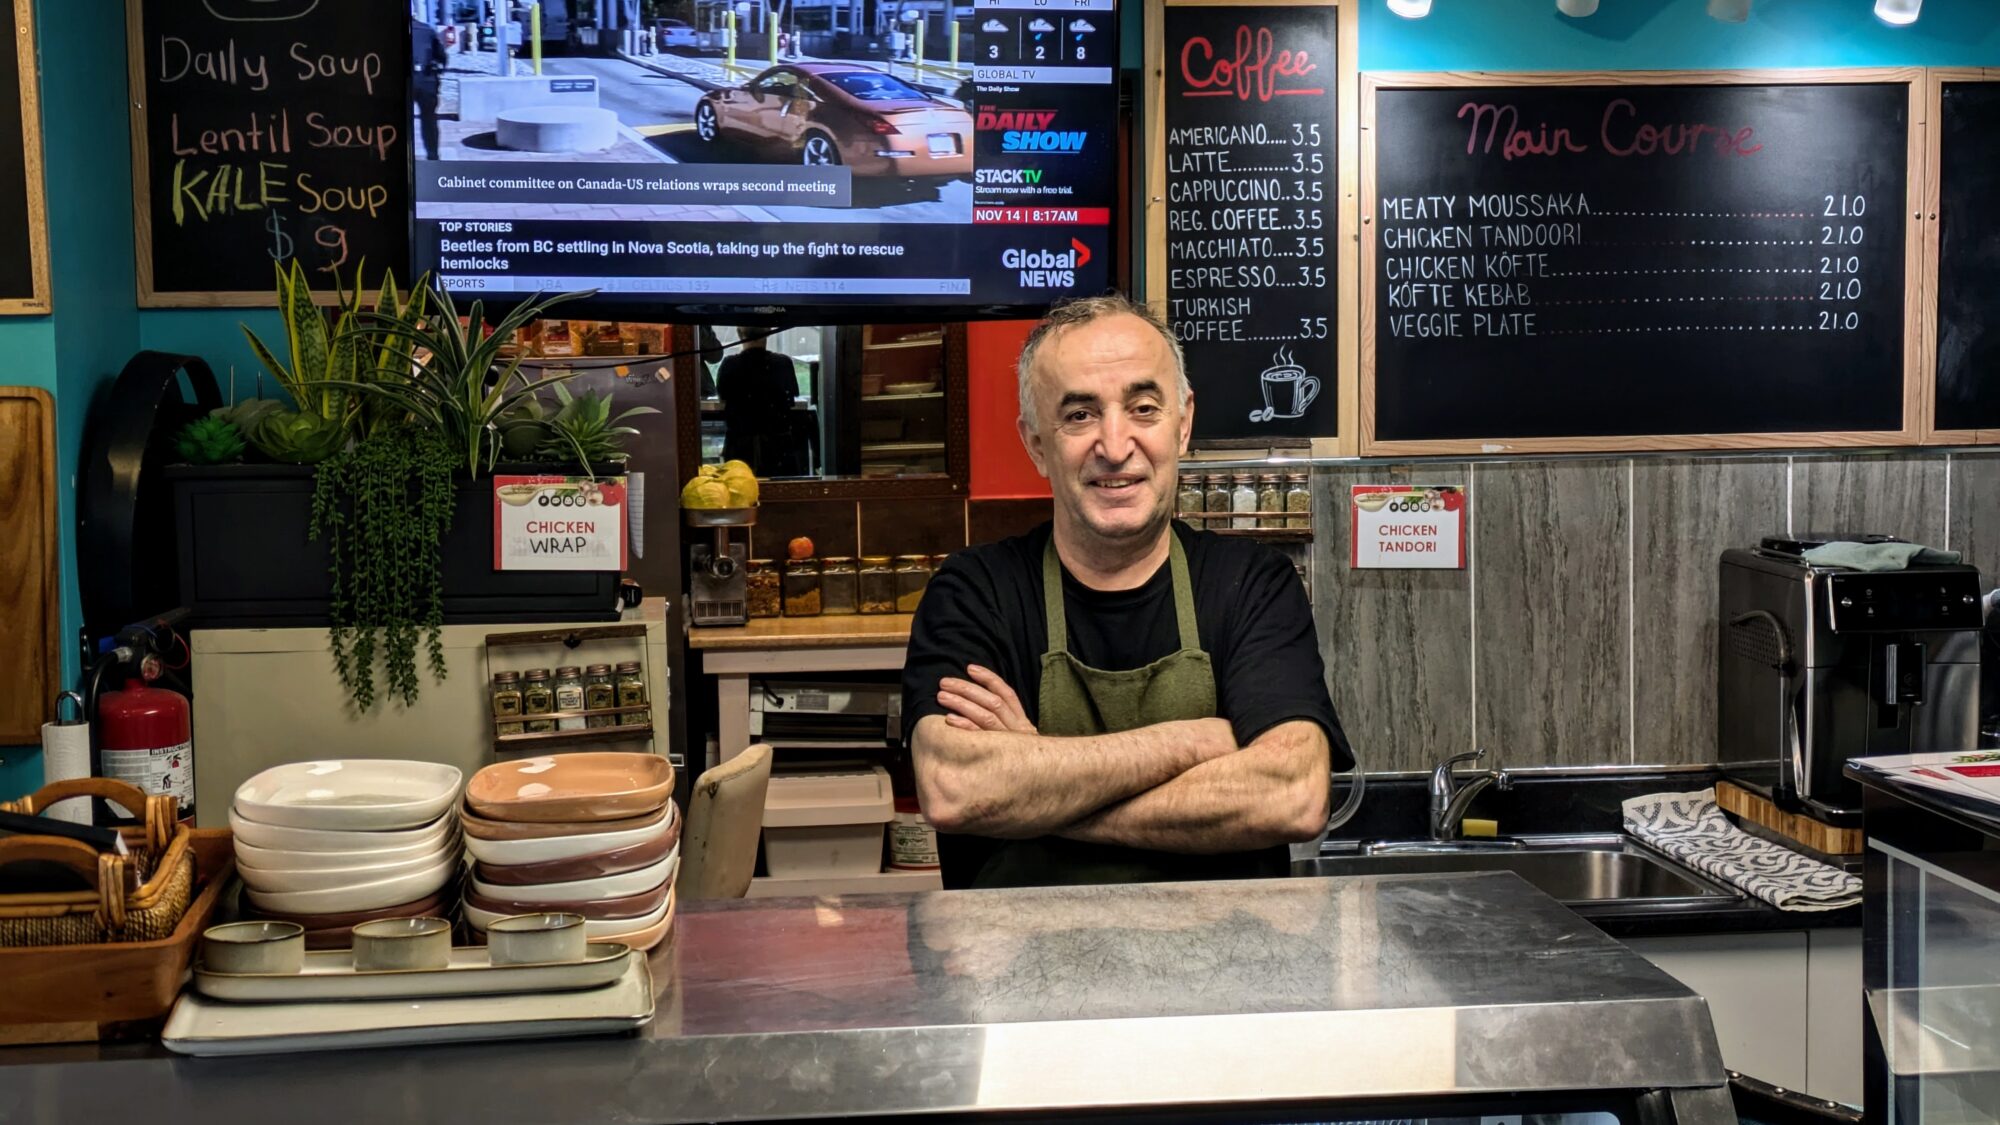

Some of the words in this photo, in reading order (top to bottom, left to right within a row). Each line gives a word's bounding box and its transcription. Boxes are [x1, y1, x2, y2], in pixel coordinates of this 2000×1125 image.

[989, 45, 999, 59] 3
[1035, 46, 1045, 59] 2
[1076, 46, 1086, 60] 8
[290, 43, 381, 95] Soup
[1181, 25, 1317, 102] Coffee
[977, 70, 1018, 80] GLOBAL
[1022, 70, 1036, 80] TV
[988, 85, 1003, 94] Daily
[976, 112, 1056, 131] DAILY
[1457, 102, 1588, 161] Main
[1600, 99, 1763, 157] Course
[172, 108, 291, 154] Lentil
[306, 113, 397, 160] Soup
[1002, 131, 1087, 150] SHOW
[1292, 123, 1321, 147] 3.5
[1292, 153, 1324, 174] 3.5
[437, 176, 486, 188] Cabinet
[489, 177, 555, 189] committee
[557, 179, 573, 189] on
[576, 178, 643, 190] Canada-US
[646, 179, 700, 191] relations
[702, 181, 740, 194] wraps
[741, 181, 784, 192] second
[787, 181, 836, 195] meeting
[975, 169, 1042, 183] STACKTV
[172, 159, 290, 227] KALE
[297, 174, 387, 218] Soup
[975, 186, 1001, 194] Stream
[1019, 186, 1035, 194] with
[1043, 186, 1058, 194] free
[1292, 181, 1323, 202] 3.5
[976, 210, 1003, 221] NOV
[1006, 210, 1021, 221] 14
[1033, 210, 1078, 222] 8:17AM
[1383, 195, 1456, 220] MEATY
[1823, 195, 1866, 217] 21.0
[439, 221, 462, 232] TOP
[465, 222, 512, 232] STORIES
[1169, 210, 1207, 232] REG.
[1293, 209, 1323, 230] 3.5
[266, 209, 294, 261] $
[315, 225, 348, 272] 9
[1384, 225, 1472, 249] CHICKEN
[1821, 225, 1864, 246] 21.0
[440, 239, 493, 252] Beetles
[496, 239, 530, 252] from
[533, 240, 553, 253] BC
[557, 240, 609, 256] settling
[612, 241, 625, 253] in
[628, 241, 664, 253] Nova
[667, 241, 714, 256] Scotia,
[717, 241, 759, 257] taking
[762, 245, 779, 258] up
[782, 242, 805, 254] the
[808, 242, 839, 258] fight
[841, 243, 855, 255] to
[858, 245, 904, 255] rescue
[1295, 238, 1324, 258] 3.5
[440, 257, 509, 270] hemlocks
[1002, 248, 1076, 269] Global
[1386, 254, 1475, 280] CHICKEN
[1820, 257, 1860, 275] 21.0
[442, 278, 485, 289] SPORTS
[1020, 270, 1075, 287] NEWS
[1298, 266, 1326, 288] 3.5
[1819, 278, 1861, 300] 21.0
[1173, 297, 1250, 318] TURKISH
[1299, 318, 1328, 339] 3.5
[1390, 313, 1463, 337] VEGGIE
[1819, 311, 1859, 331] 21.0
[526, 521, 595, 534] CHICKEN
[1378, 525, 1437, 536] CHICKEN
[530, 537, 587, 553] WRAP
[1379, 541, 1437, 553] TANDORI
